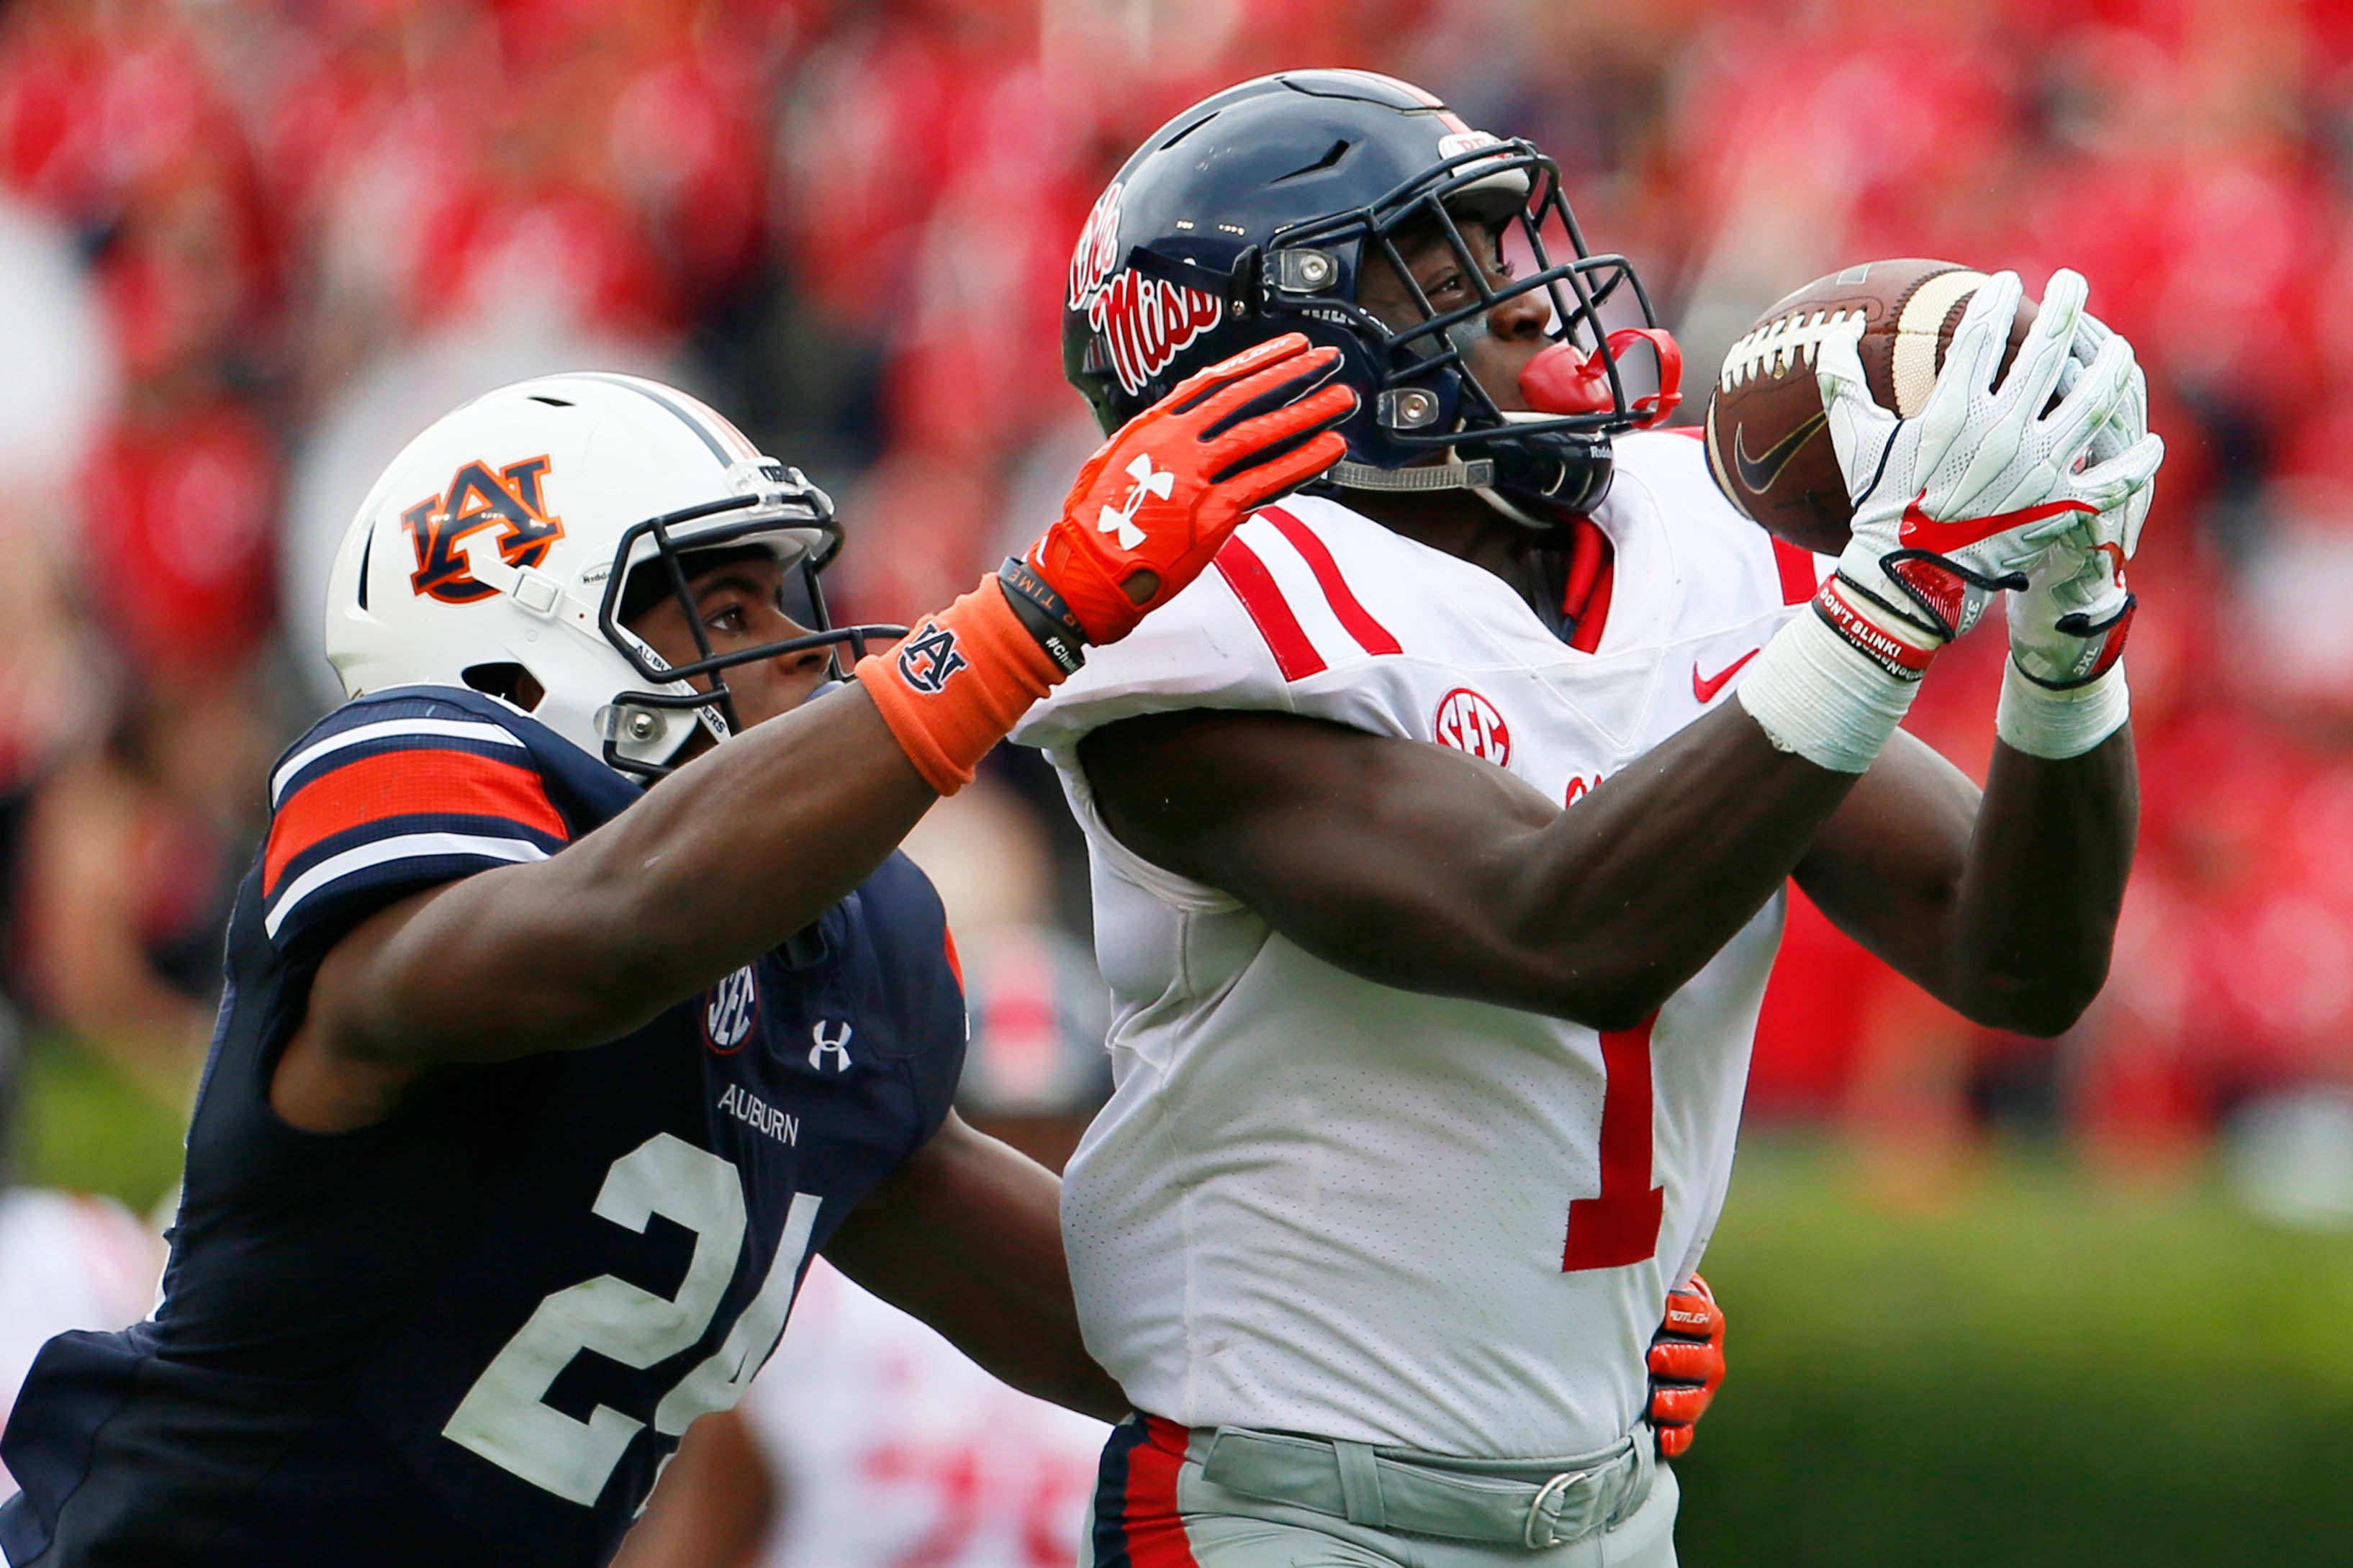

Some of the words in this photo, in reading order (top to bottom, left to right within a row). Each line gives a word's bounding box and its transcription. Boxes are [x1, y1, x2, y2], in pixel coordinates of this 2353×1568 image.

[1088, 258, 1222, 396] Miss
[1820, 586, 1853, 625] DON'T
[2072, 646, 2099, 676] 3XL
[1440, 692, 1507, 766] SEC
[708, 964, 755, 1046] SEC
[717, 1083, 800, 1148] AUBURN
[441, 1131, 823, 1521] 24
